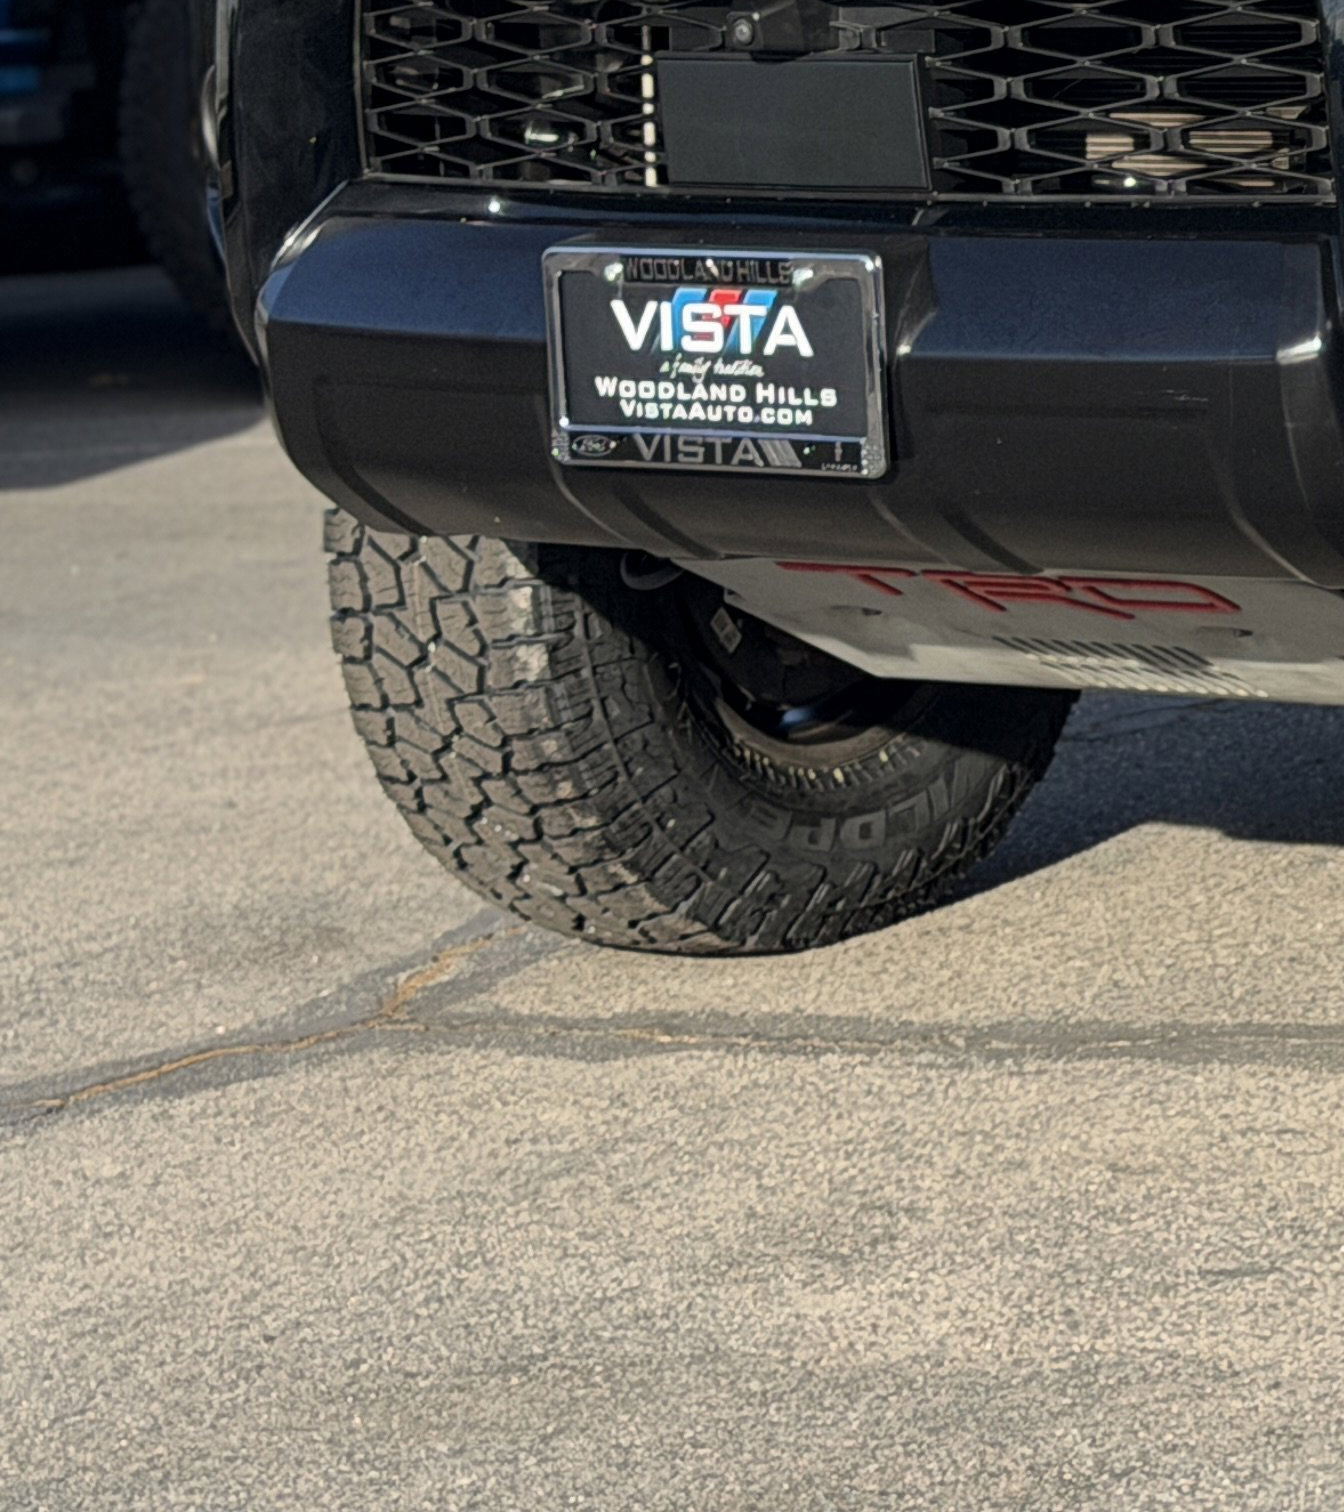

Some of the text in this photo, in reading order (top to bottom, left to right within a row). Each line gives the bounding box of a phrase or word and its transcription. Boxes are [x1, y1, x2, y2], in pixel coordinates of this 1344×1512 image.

[610, 298, 815, 357] VISTA
[594, 376, 838, 408] WOODLAND HILLS
[632, 433, 764, 467] VISTA
[774, 561, 1242, 621] TRD
